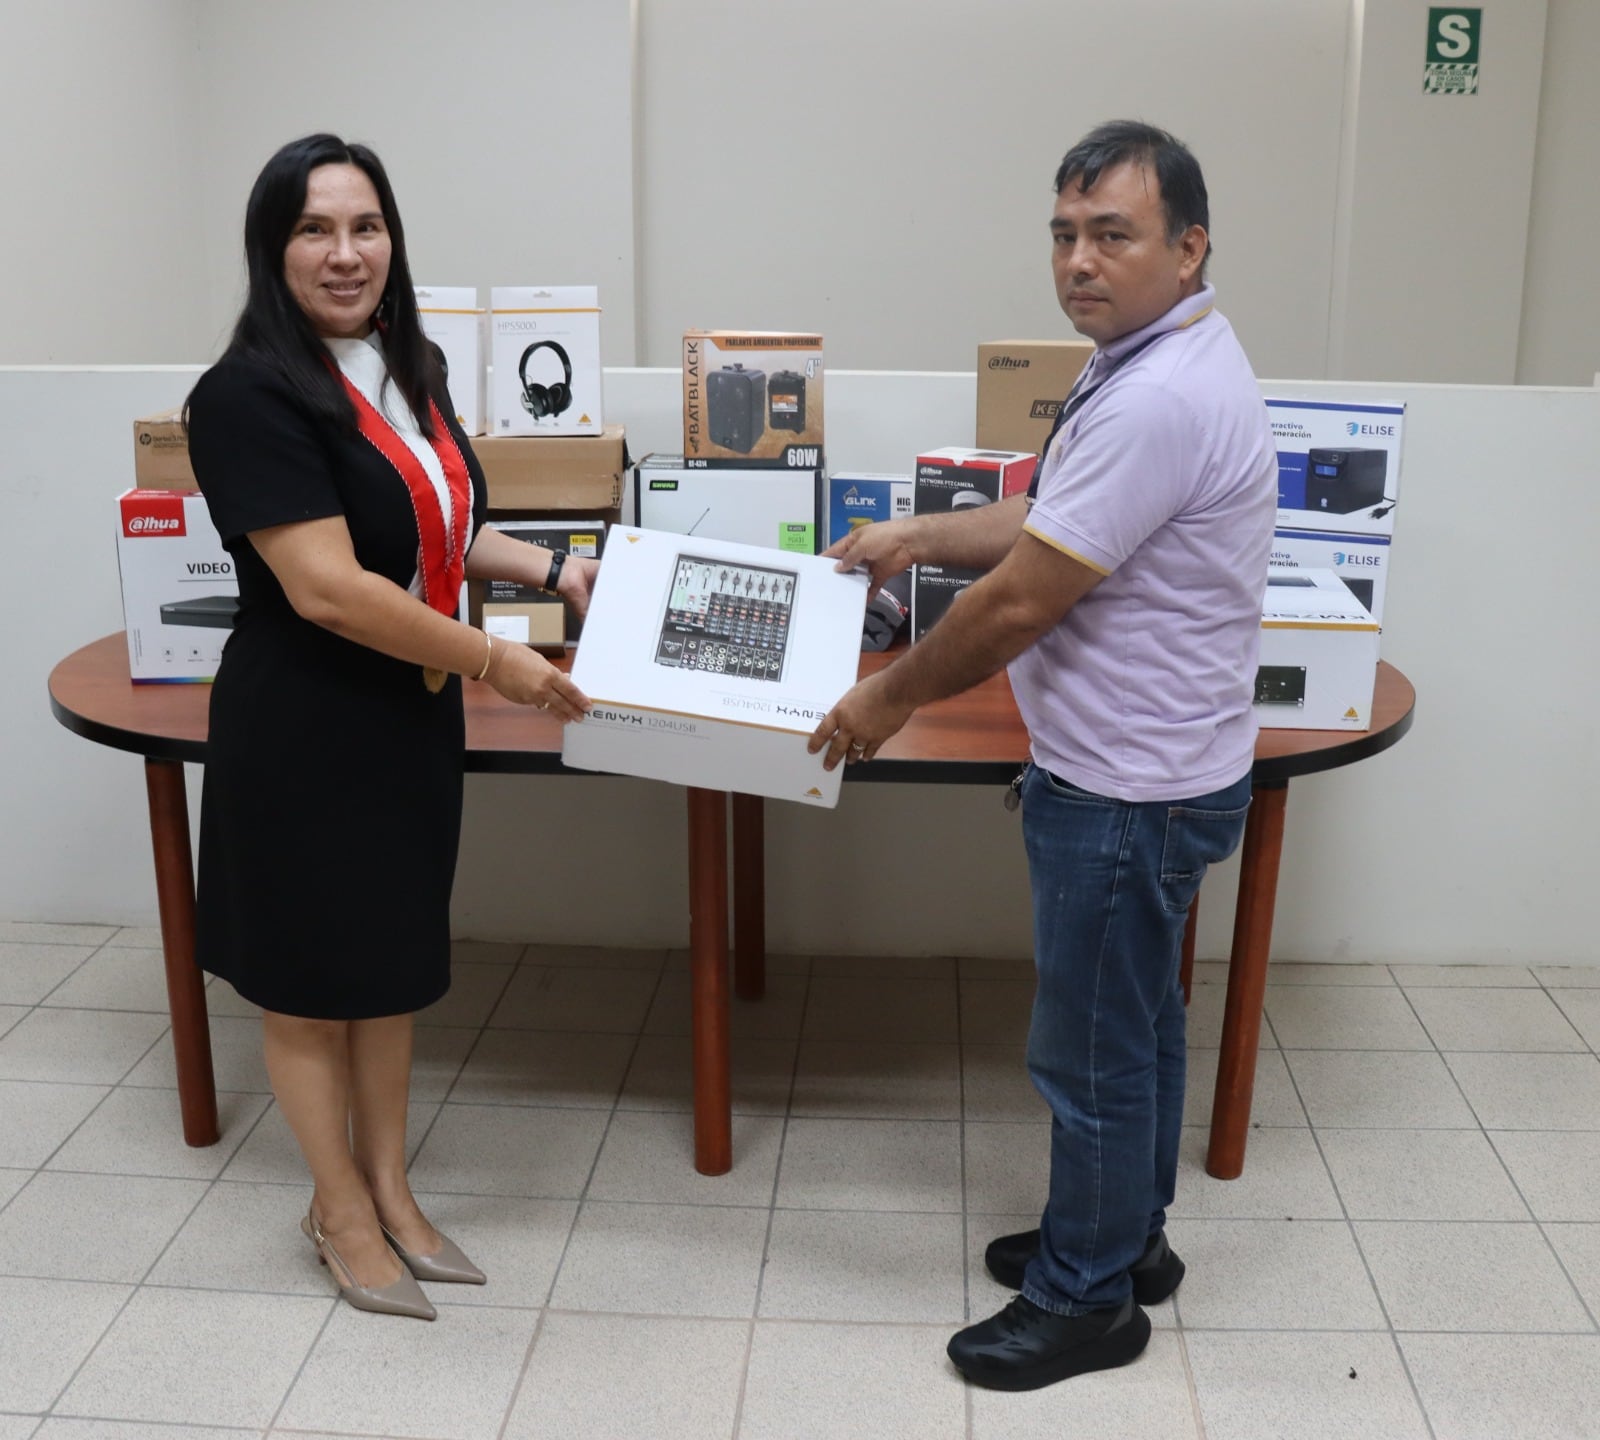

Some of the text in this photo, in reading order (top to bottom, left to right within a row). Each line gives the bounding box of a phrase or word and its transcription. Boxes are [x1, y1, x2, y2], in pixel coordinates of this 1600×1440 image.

[1436, 14, 1471, 58] S
[498, 320, 537, 331] HPS5000
[687, 341, 699, 435] BATBLACK
[1361, 424, 1395, 436] ELISE
[787, 448, 818, 467] 60W
[1347, 554, 1381, 566] ELISE
[186, 562, 231, 574] VIDEO
[648, 718, 697, 733] 1204USB
